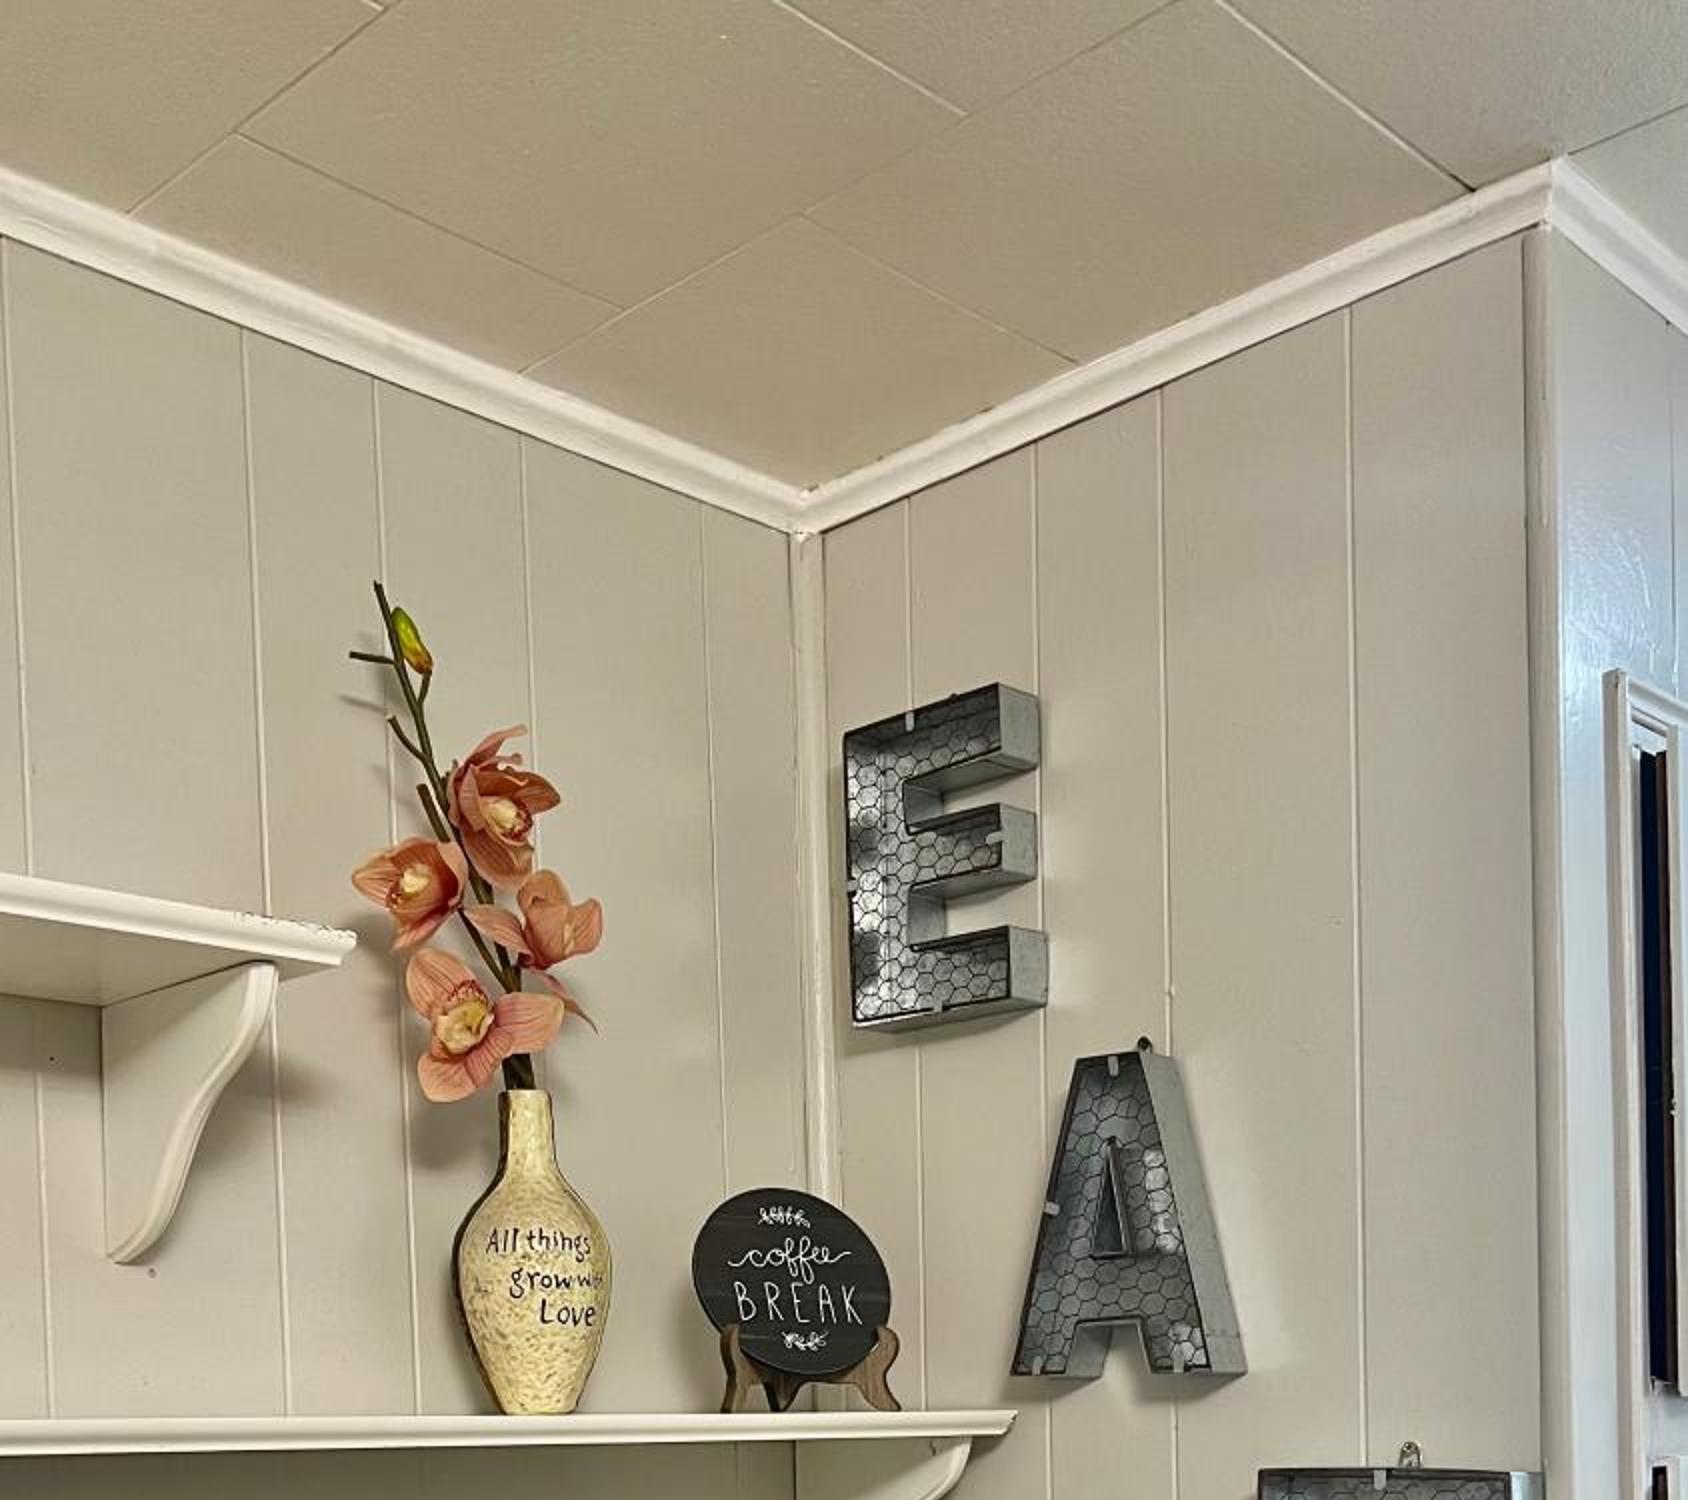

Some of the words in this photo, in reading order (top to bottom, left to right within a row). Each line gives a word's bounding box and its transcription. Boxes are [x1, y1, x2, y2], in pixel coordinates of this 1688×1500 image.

[486, 1227, 520, 1254] All
[527, 1227, 591, 1263] things
[727, 1235, 852, 1285] coffee
[509, 1267, 572, 1300] grow
[540, 1299, 597, 1328] Love
[733, 1281, 863, 1325] BREAK
